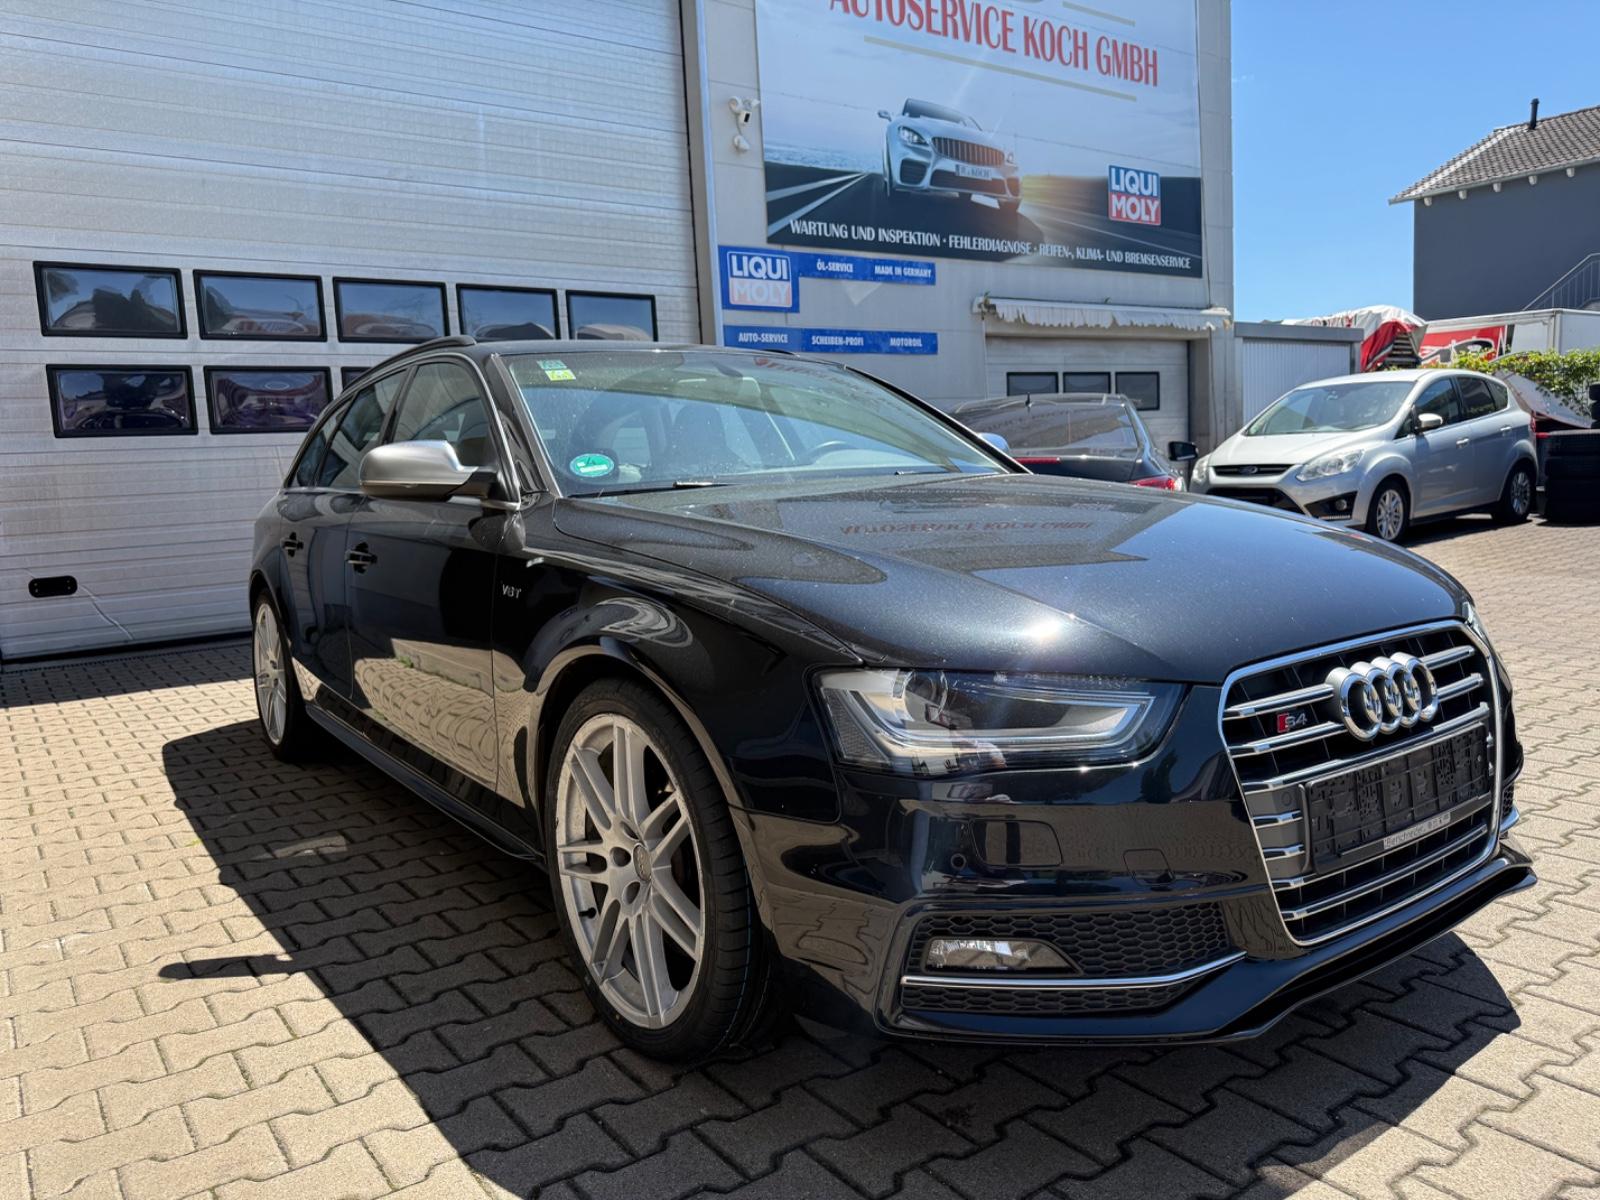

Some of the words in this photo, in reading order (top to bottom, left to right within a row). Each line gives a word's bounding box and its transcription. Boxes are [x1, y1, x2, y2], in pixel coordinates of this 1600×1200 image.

[1023, 15, 1089, 71] KOCH
[1095, 35, 1158, 88] GMBH
[1109, 166, 1158, 198] LIQUI
[1110, 197, 1160, 222] MOLY
[789, 219, 848, 239] WARTUNG
[851, 225, 876, 242] UND
[878, 228, 941, 248] INSPEKTION
[948, 234, 1033, 255] FEHLERDIAGNOSE
[1076, 246, 1105, 262] KLIMA-
[1106, 249, 1124, 263] UND
[1125, 251, 1192, 269] BREMSENSERVICE
[731, 254, 789, 281] LIQUI
[816, 259, 854, 273] ÖL-SERVICE
[874, 264, 893, 275] MADE
[894, 267, 902, 276] IN
[902, 267, 932, 278] GERMANY
[734, 280, 790, 305] MOLY
[738, 332, 788, 344] AUTO-SERVICE
[811, 335, 864, 347] SCHEIBEN-PROFI
[889, 338, 923, 348] MOTOROIL
[1284, 712, 1308, 729] S4
